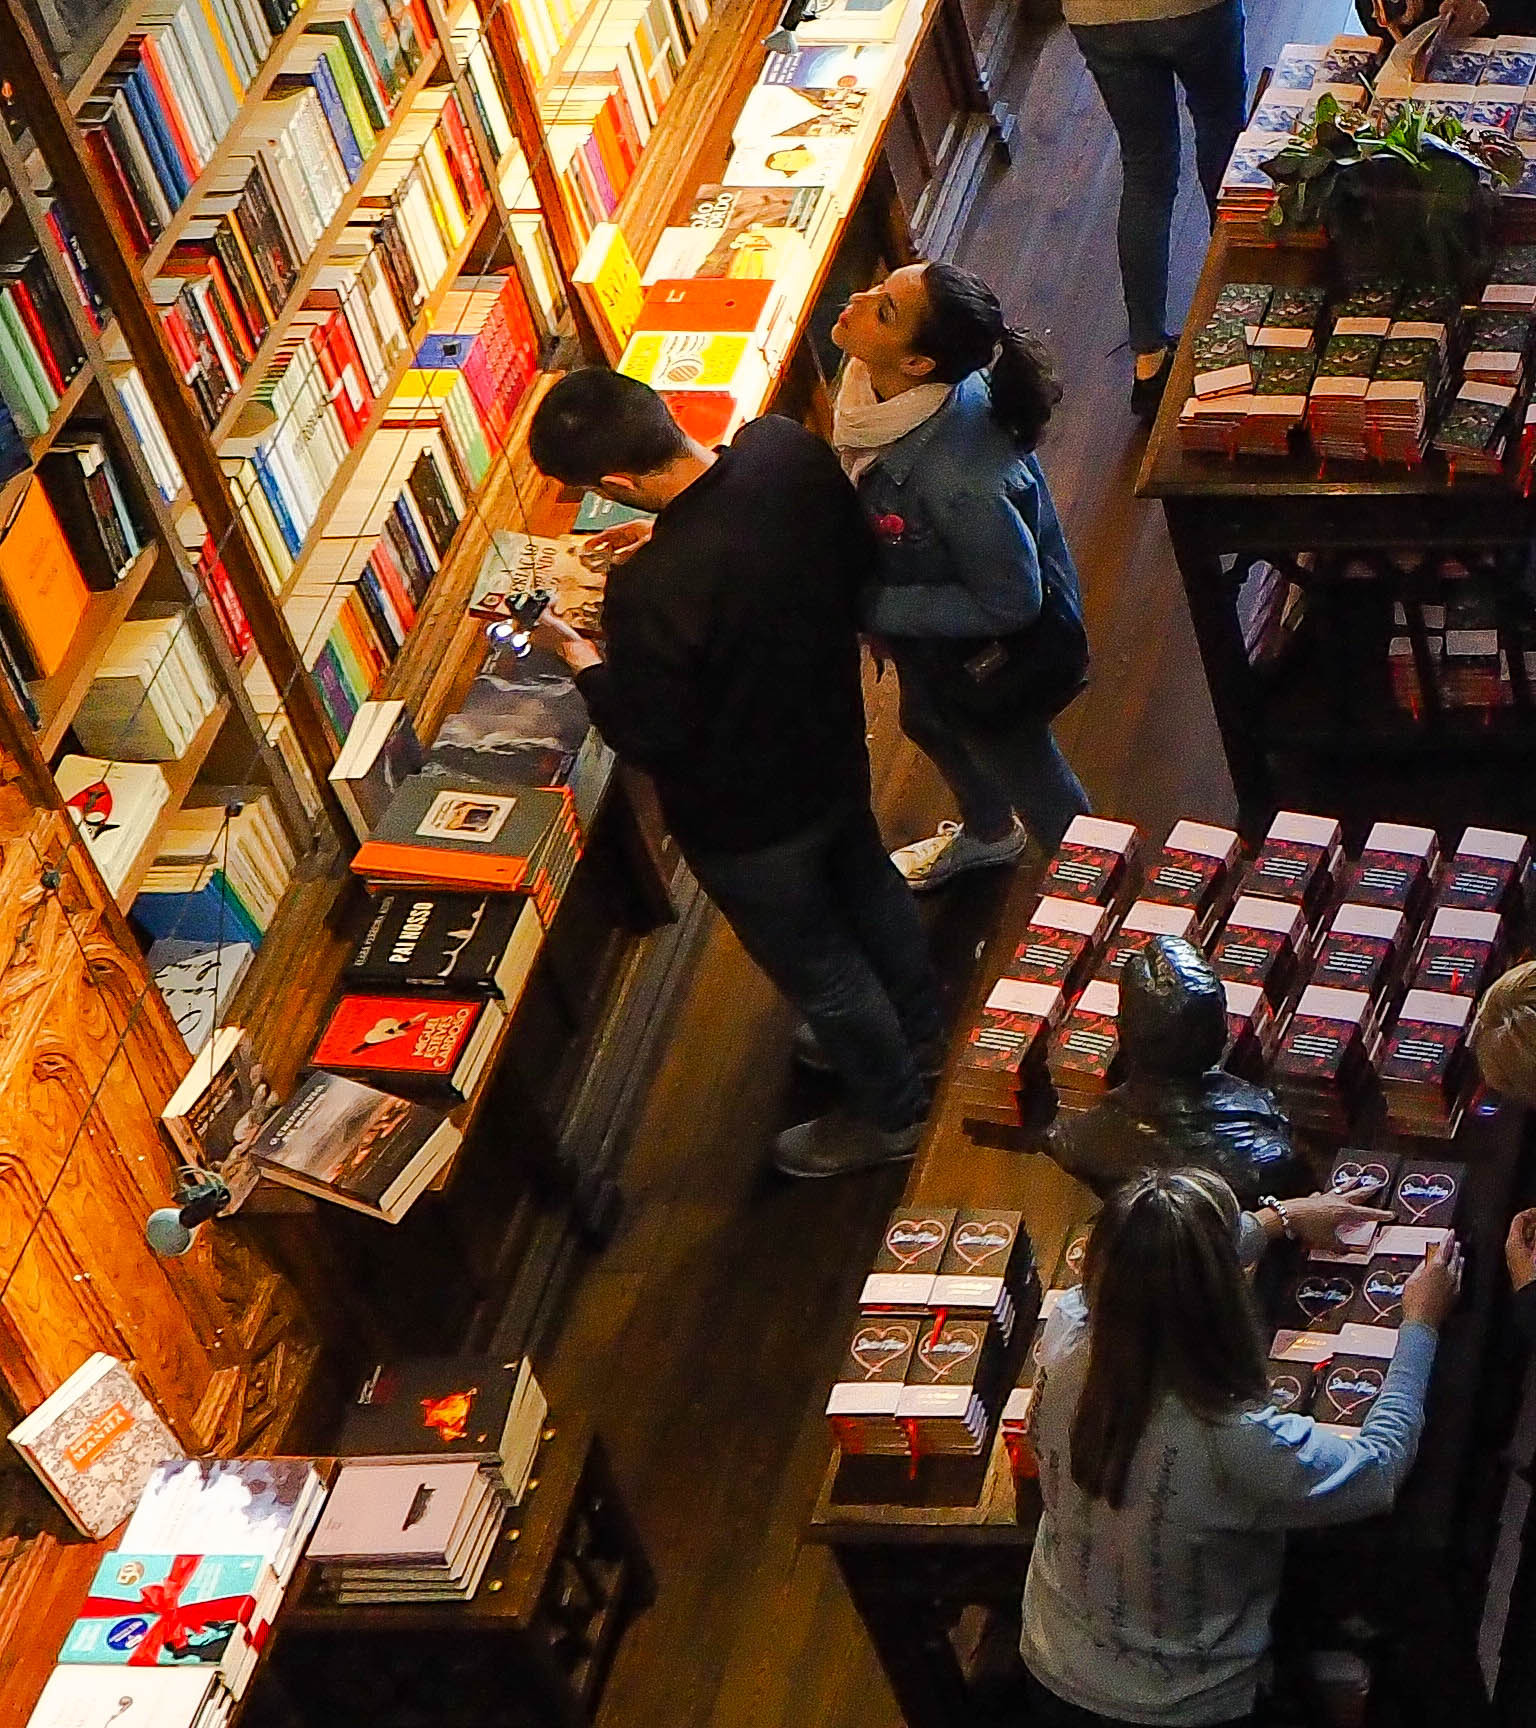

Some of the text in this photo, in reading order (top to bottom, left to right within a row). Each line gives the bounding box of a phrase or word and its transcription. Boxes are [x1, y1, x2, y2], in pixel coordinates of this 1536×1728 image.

[398, 901, 435, 941] NOSSO
[388, 940, 416, 964] PAI
[412, 1017, 440, 1057] MIGUEL
[423, 1015, 453, 1059] ESTEVES
[433, 1008, 471, 1068] CARDOSO
